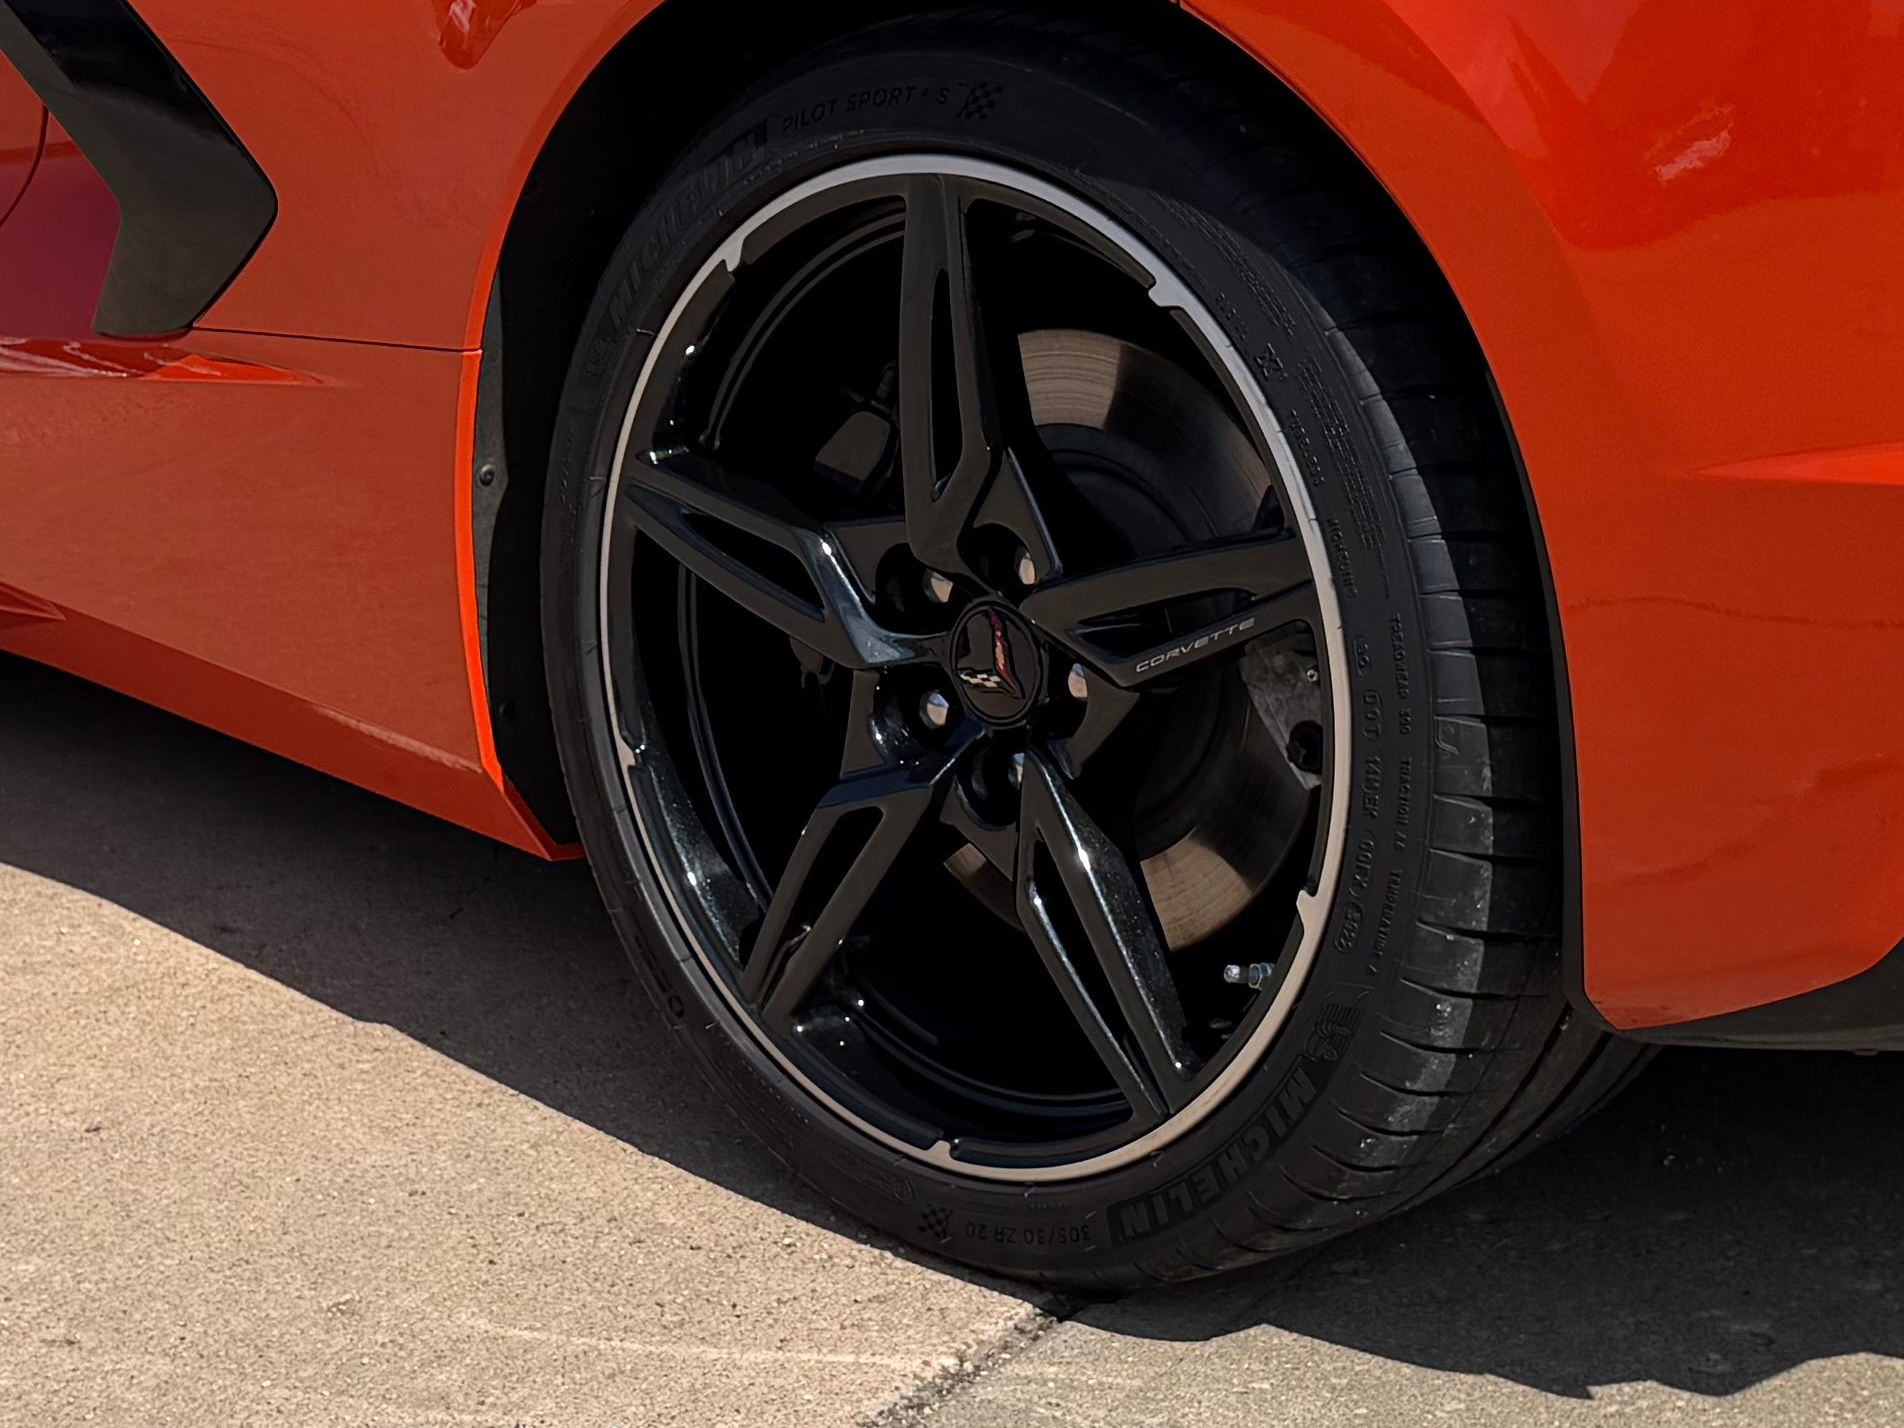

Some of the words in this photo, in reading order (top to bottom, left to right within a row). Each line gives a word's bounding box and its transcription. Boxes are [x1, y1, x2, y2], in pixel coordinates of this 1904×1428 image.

[782, 98, 839, 134] PILOT
[845, 84, 918, 112] SPORT
[1136, 617, 1255, 673] CORVETTE
[1119, 1067, 1317, 1239] MICHELIN
[964, 1220, 988, 1241] 20
[1024, 1223, 1092, 1246] 305/30
